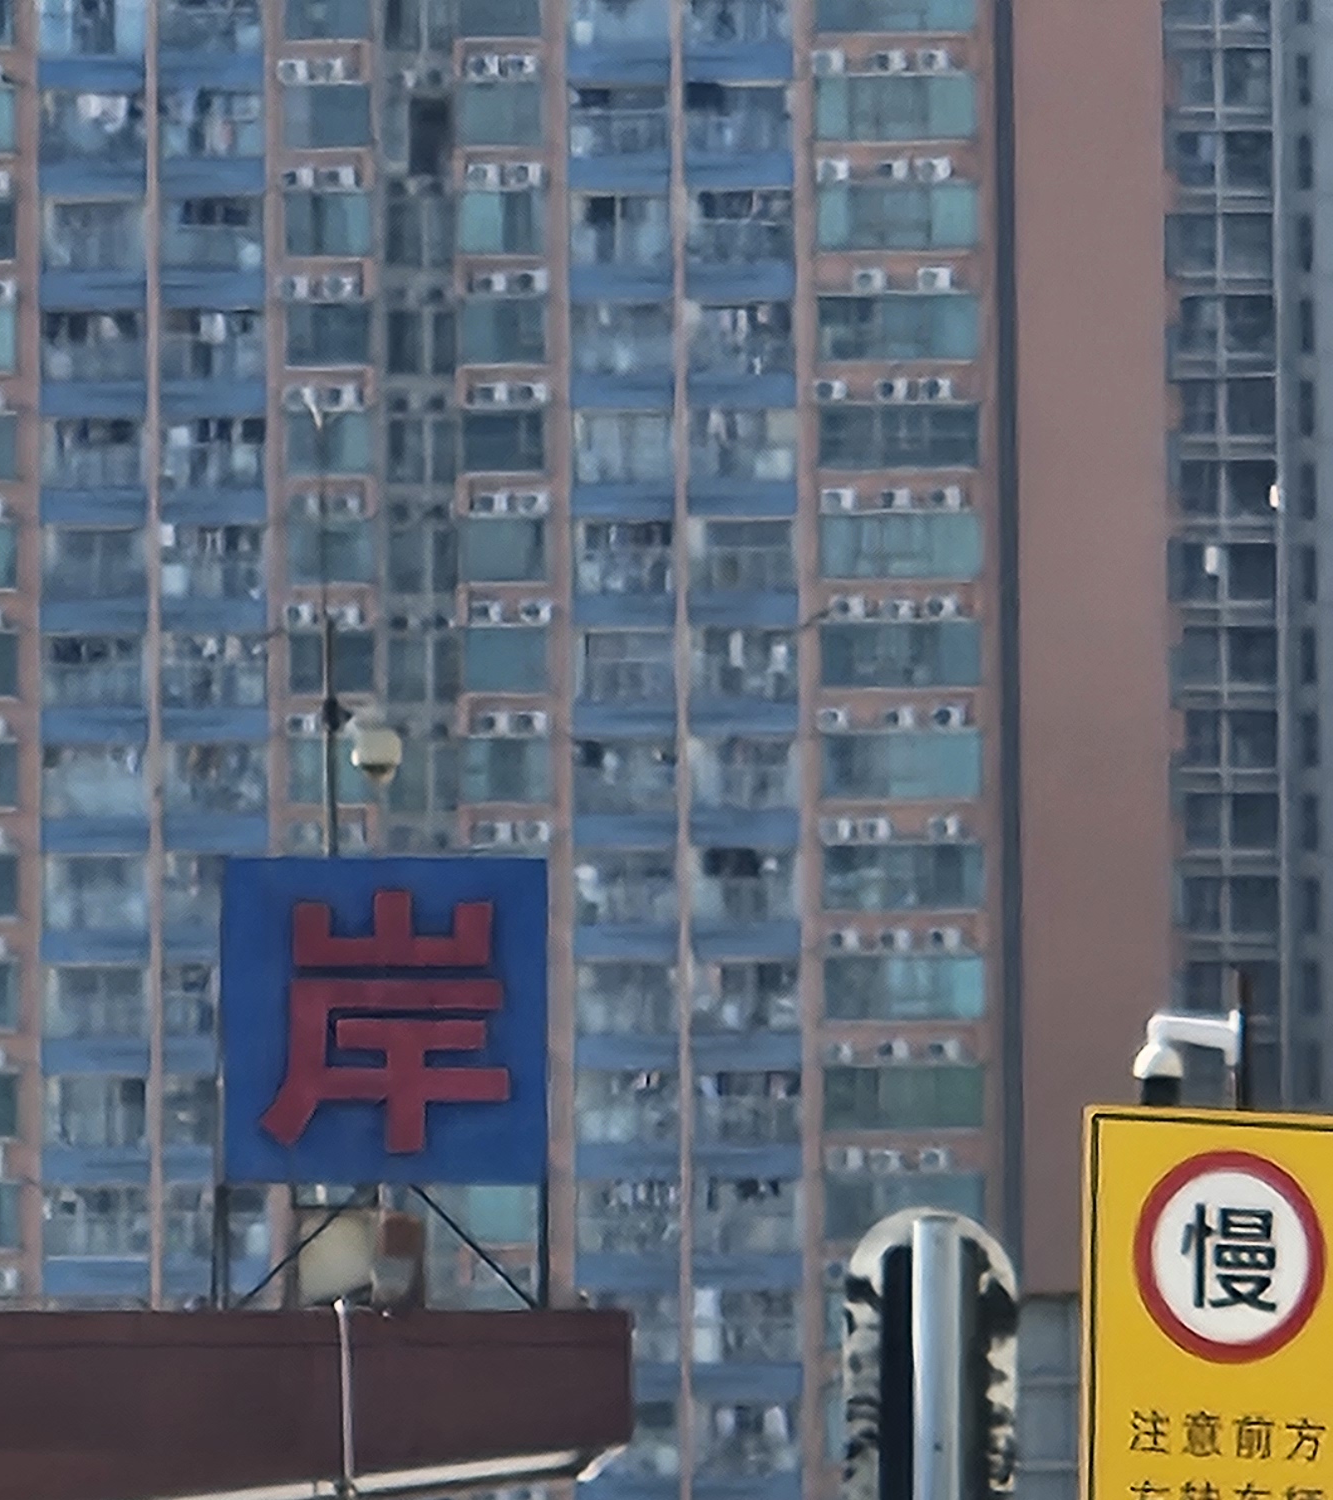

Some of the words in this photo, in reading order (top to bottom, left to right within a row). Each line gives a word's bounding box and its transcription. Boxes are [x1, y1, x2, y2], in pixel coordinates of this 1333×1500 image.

[1180, 1202, 1278, 1312] 慢
[1128, 1409, 1327, 1463] 注意前方
